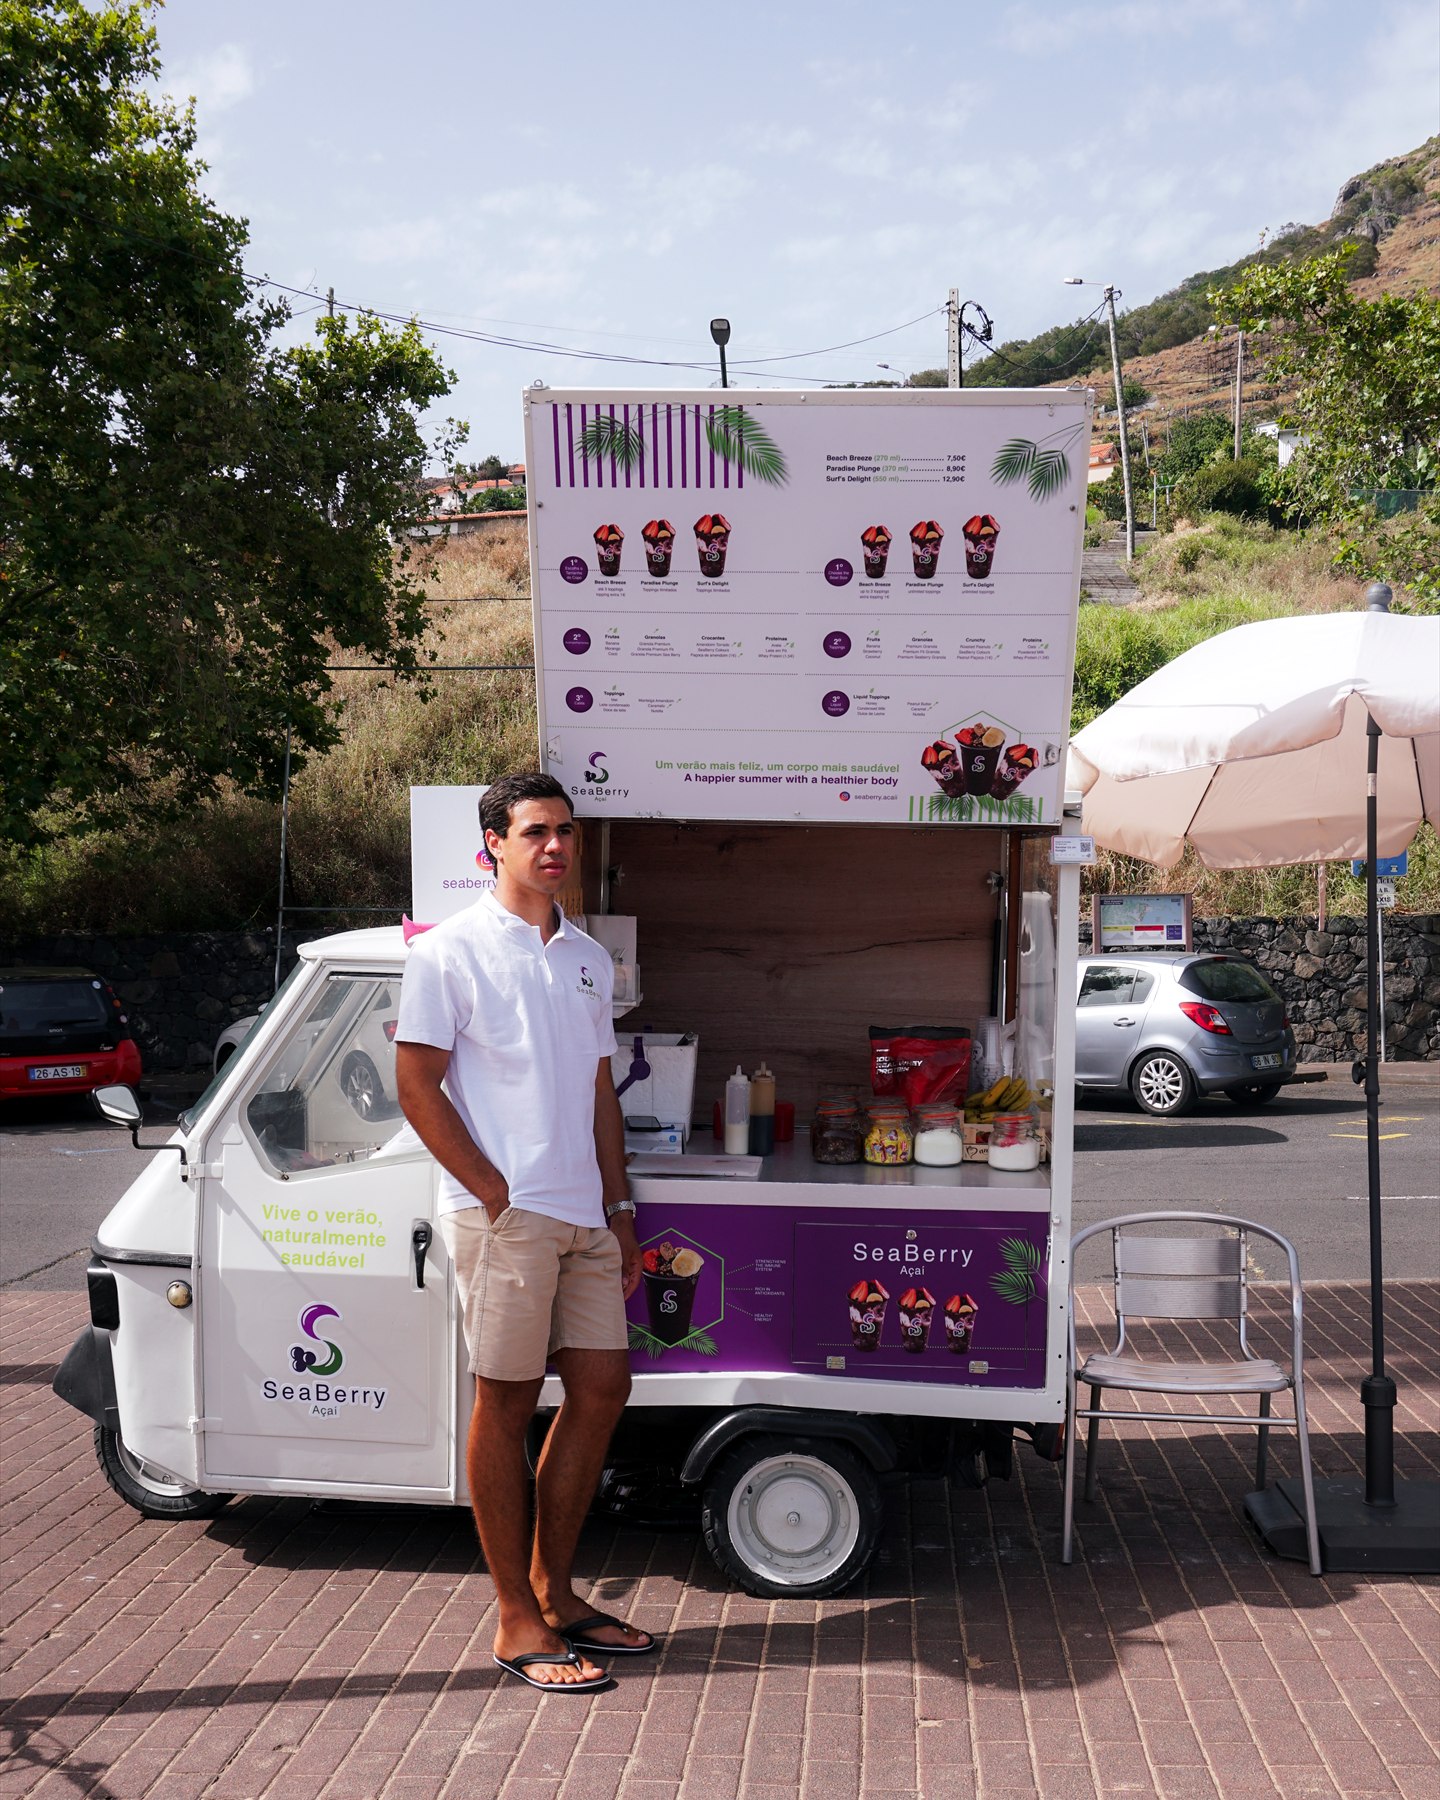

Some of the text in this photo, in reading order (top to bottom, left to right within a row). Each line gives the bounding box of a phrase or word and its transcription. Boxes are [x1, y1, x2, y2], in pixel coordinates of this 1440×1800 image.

[847, 475, 871, 483] Delight
[656, 760, 673, 769] Um
[676, 760, 706, 770] verão
[710, 761, 736, 770] mais
[738, 761, 764, 772] feliz,
[787, 764, 818, 774] corpo
[822, 764, 848, 772] mais
[850, 764, 900, 773] saudável
[684, 774, 692, 782] A
[695, 774, 736, 785] happier
[738, 775, 783, 784] summer
[785, 775, 808, 784] with
[821, 776, 868, 786] healthier
[871, 776, 898, 788] body
[571, 786, 629, 797] SeaBerry
[262, 1204, 383, 1228] Vive o verão,
[262, 1227, 386, 1247] naturalmente
[281, 1252, 365, 1268] saudável
[853, 1243, 973, 1267] SeaBerry
[900, 1265, 925, 1276] Açaí
[263, 1380, 385, 1409] SeaBerry
